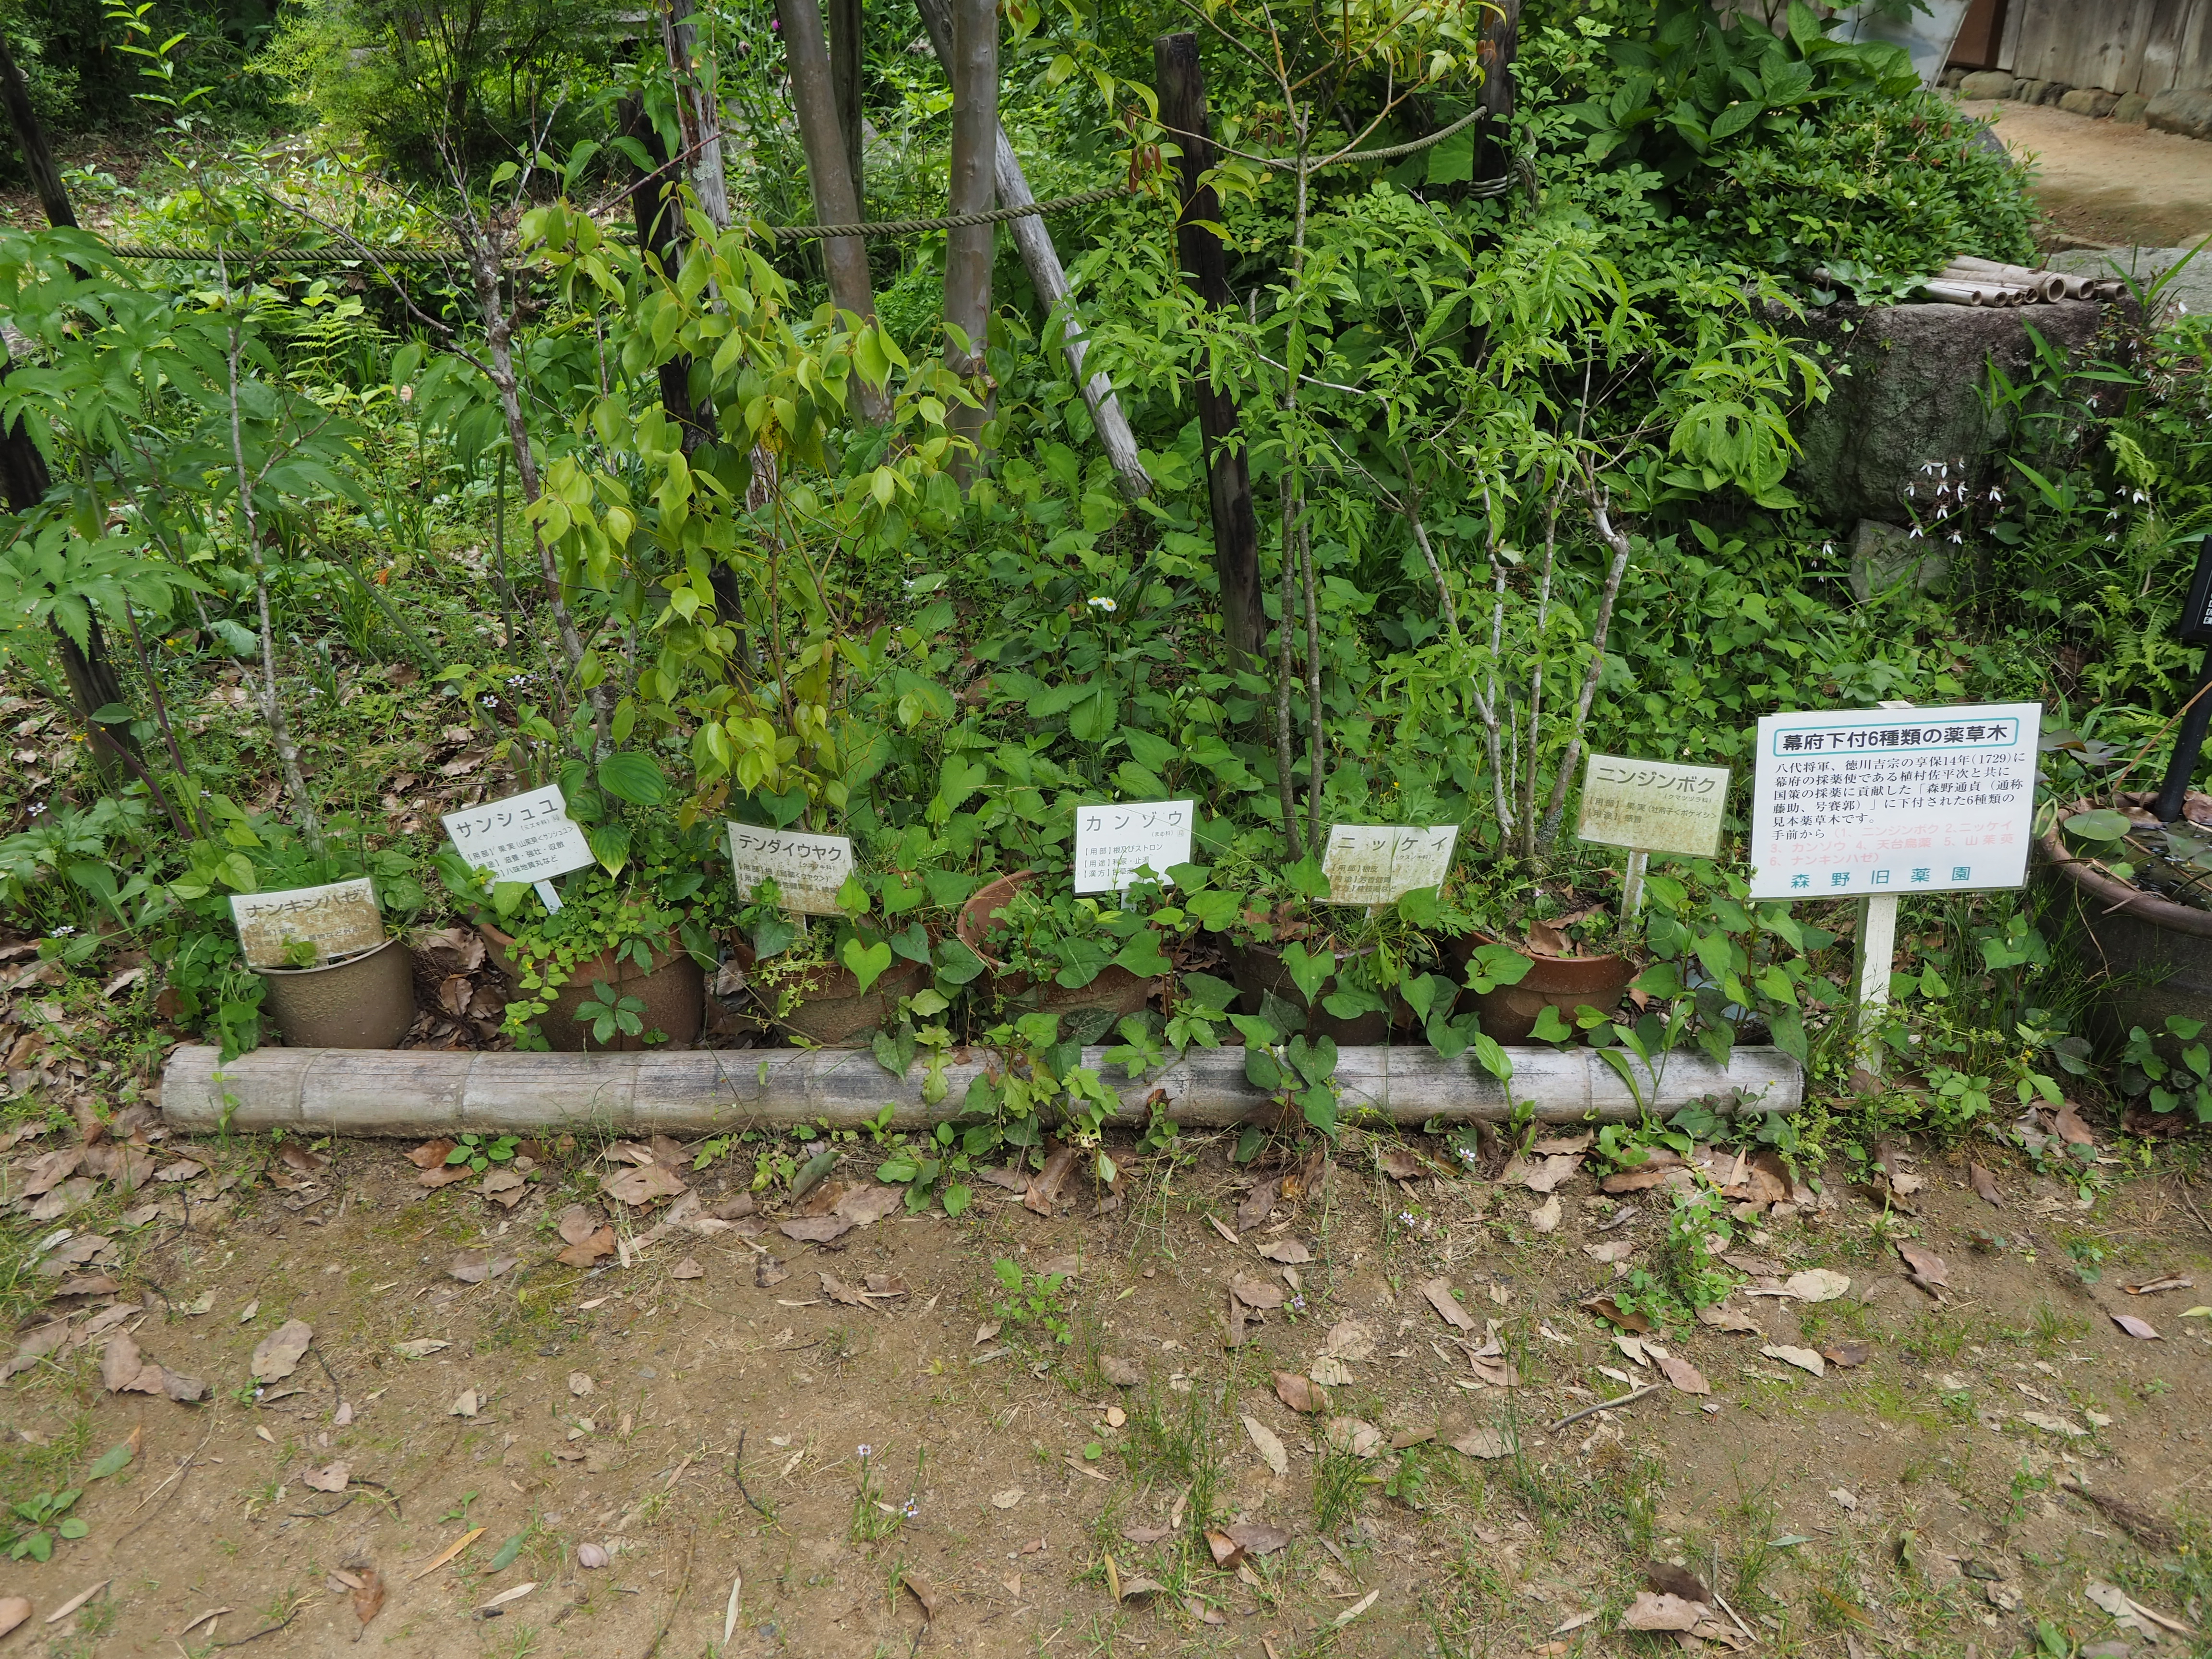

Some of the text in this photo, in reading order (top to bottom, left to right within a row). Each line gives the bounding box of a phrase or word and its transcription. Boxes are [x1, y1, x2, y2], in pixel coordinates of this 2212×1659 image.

[1782, 724, 2008, 751] 幕府下付6種類の薬草木
[1597, 768, 1716, 793] ニンジンボク
[1774, 767, 2010, 787] 幕府の採薬使である植村佐平次と共に
[456, 799, 558, 838] サンシュユ
[1086, 810, 1182, 832] カンゾウ
[1772, 813, 1874, 827] 見本薬草木です。
[739, 834, 842, 861] テンダイウヤク
[1337, 836, 1448, 851] ニッケイ
[1791, 866, 1971, 889] 森野旧薬園
[246, 889, 361, 918] ナンキンハゼ
